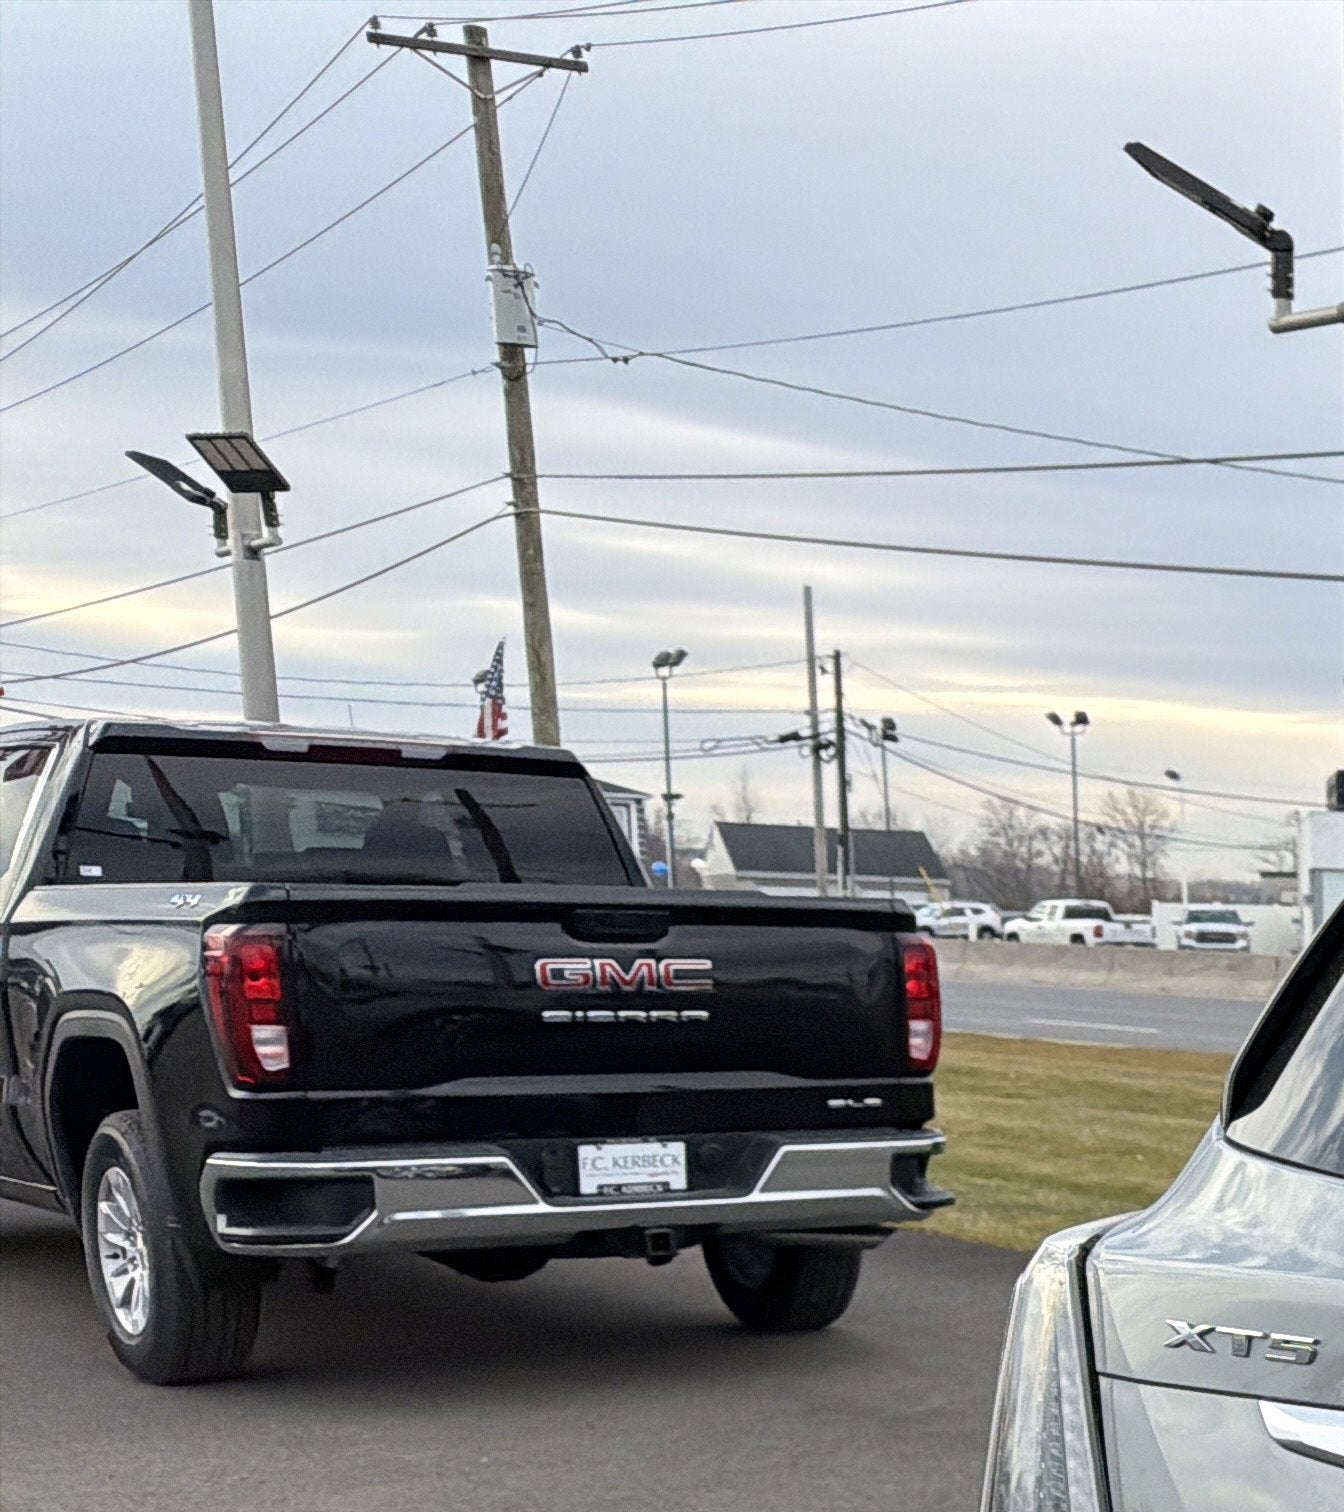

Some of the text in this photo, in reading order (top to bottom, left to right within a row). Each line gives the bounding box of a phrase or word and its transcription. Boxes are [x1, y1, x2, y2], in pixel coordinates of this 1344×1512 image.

[534, 958, 714, 993] GMC
[541, 1009, 711, 1023] SIERRA
[612, 1152, 681, 1169] KERBECK
